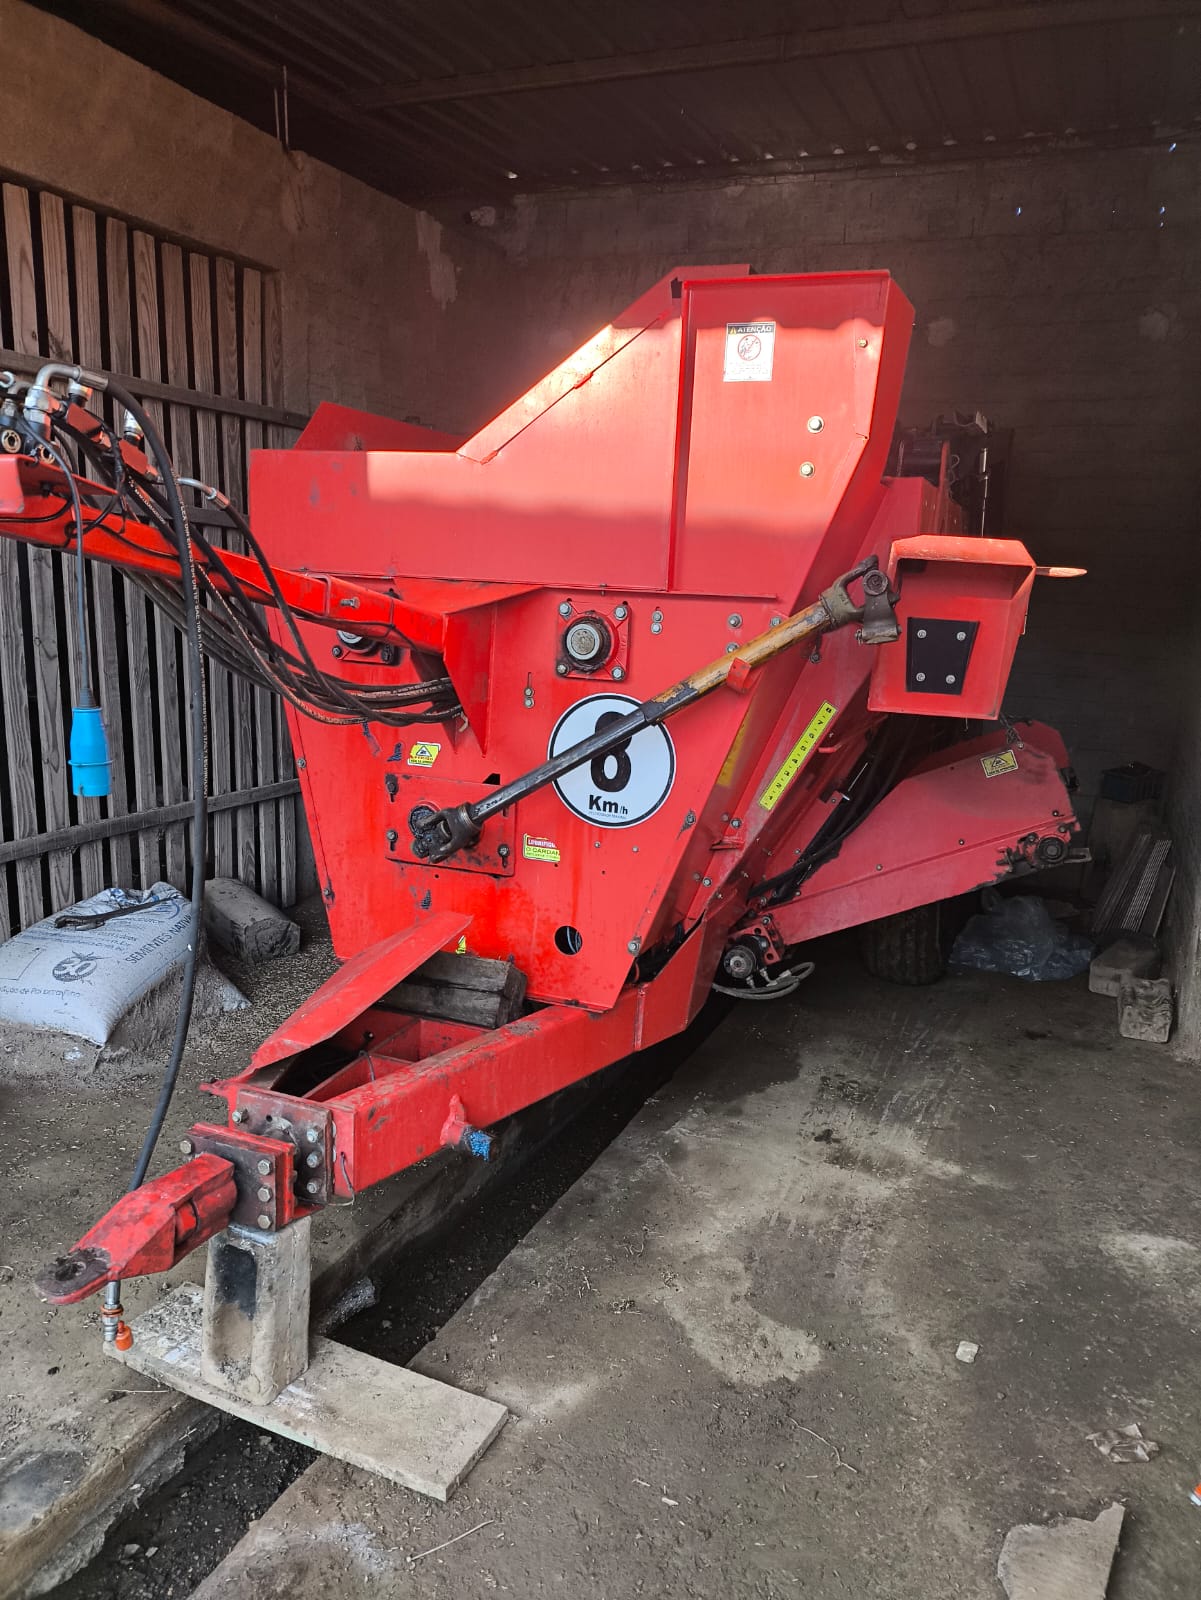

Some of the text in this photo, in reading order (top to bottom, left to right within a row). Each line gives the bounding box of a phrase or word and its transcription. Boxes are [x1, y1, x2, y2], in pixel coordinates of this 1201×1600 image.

[737, 324, 772, 333] ATENÇÃO
[589, 794, 628, 815] Km/h
[125, 932, 173, 964] SEMENTES
